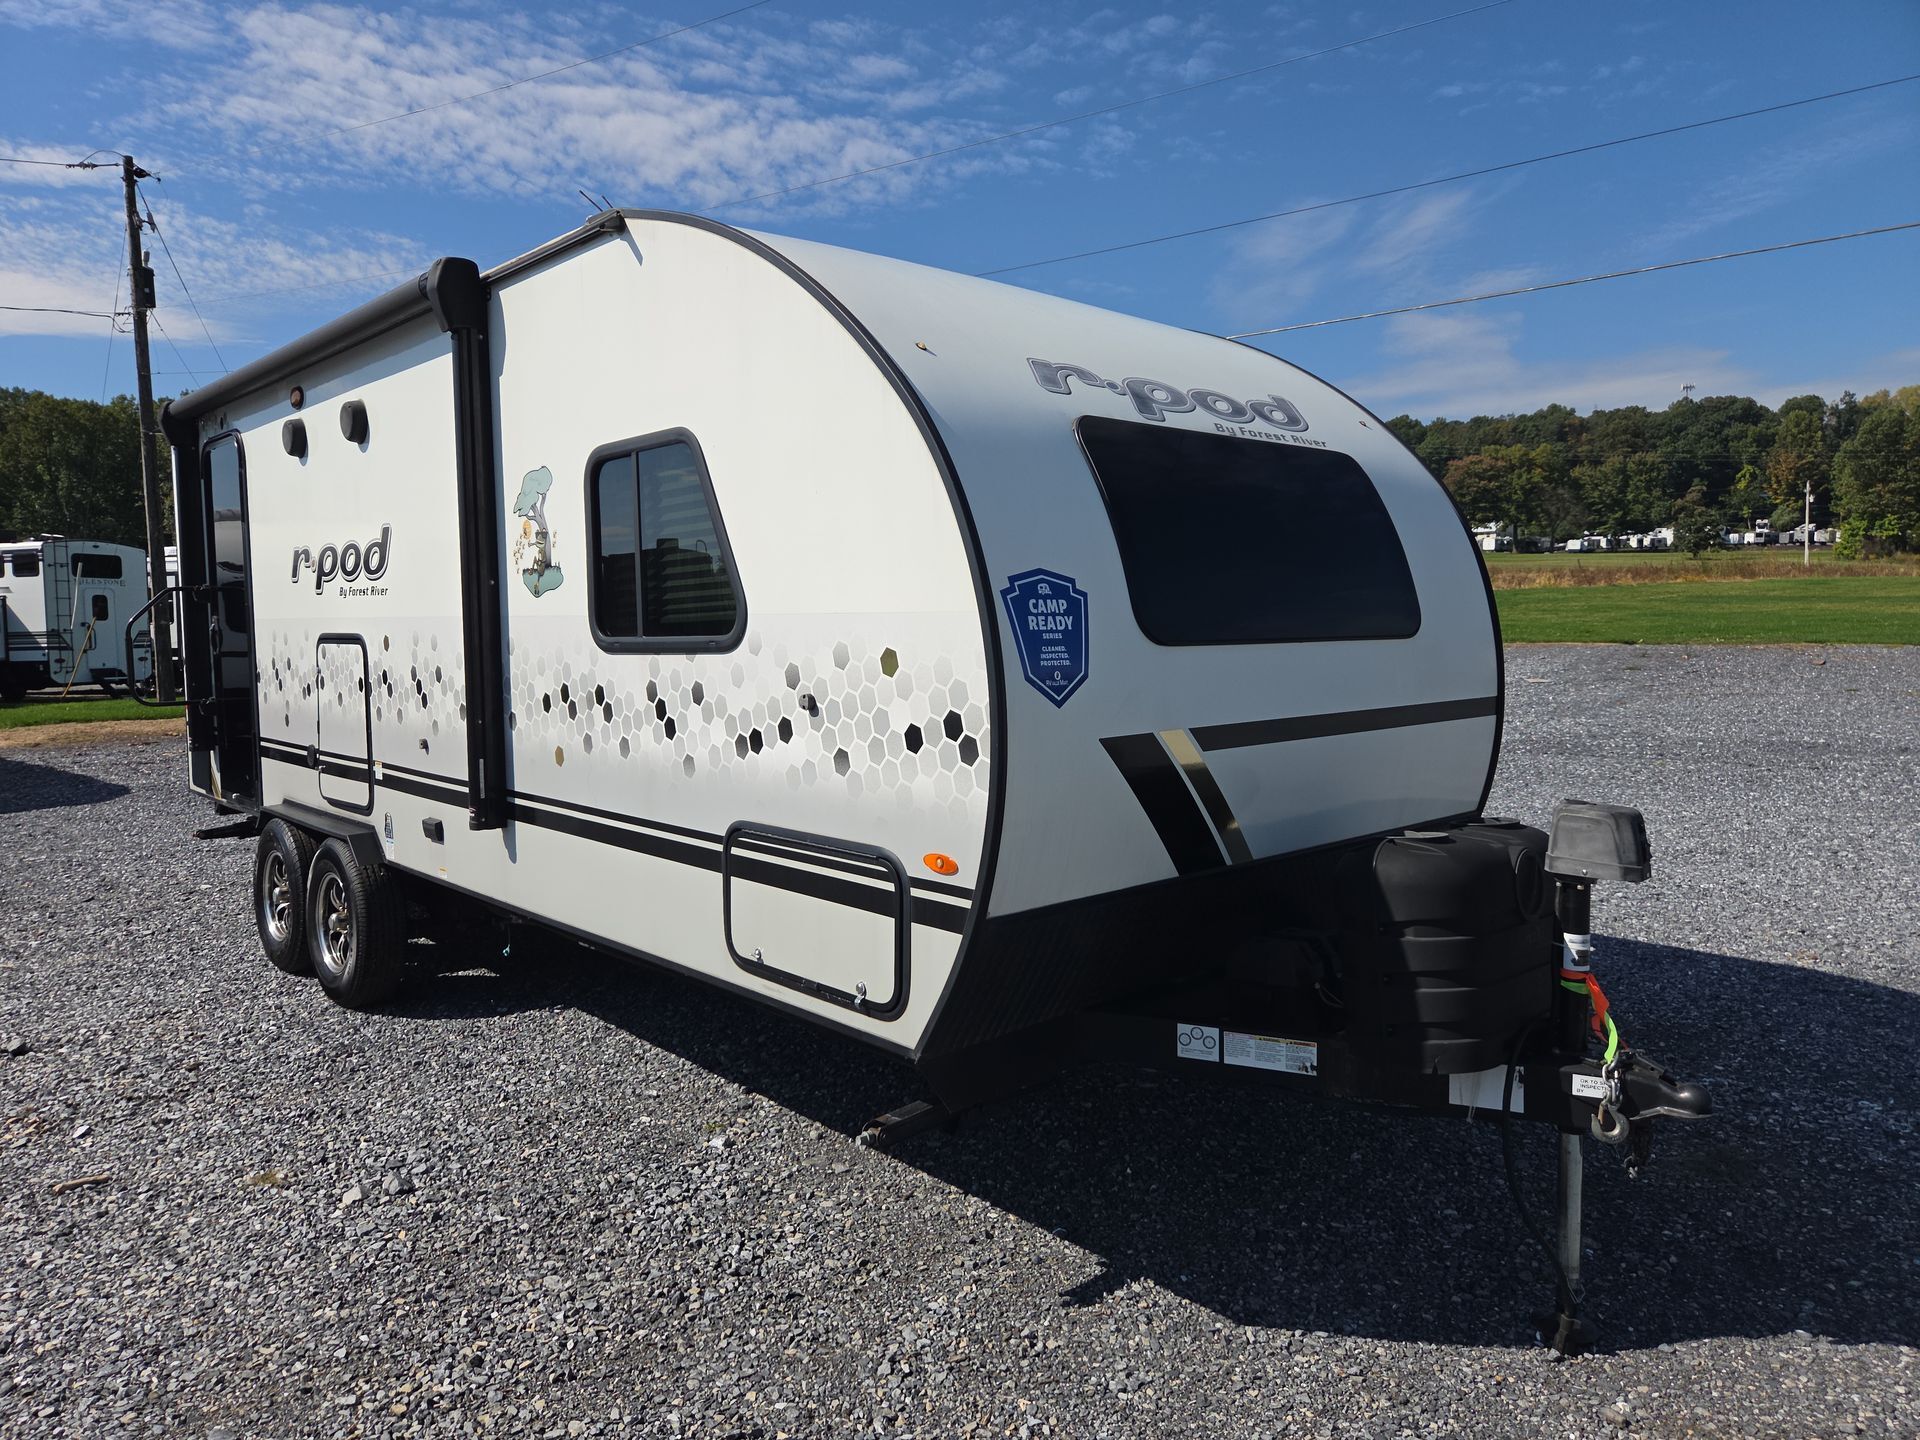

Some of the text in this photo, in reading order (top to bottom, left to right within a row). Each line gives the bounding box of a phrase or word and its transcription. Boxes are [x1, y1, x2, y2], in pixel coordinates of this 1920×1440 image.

[1214, 423, 1327, 448] By Forest River
[339, 585, 389, 599] By Forest River
[1028, 599, 1068, 614] CAMP
[1028, 615, 1073, 630] READY
